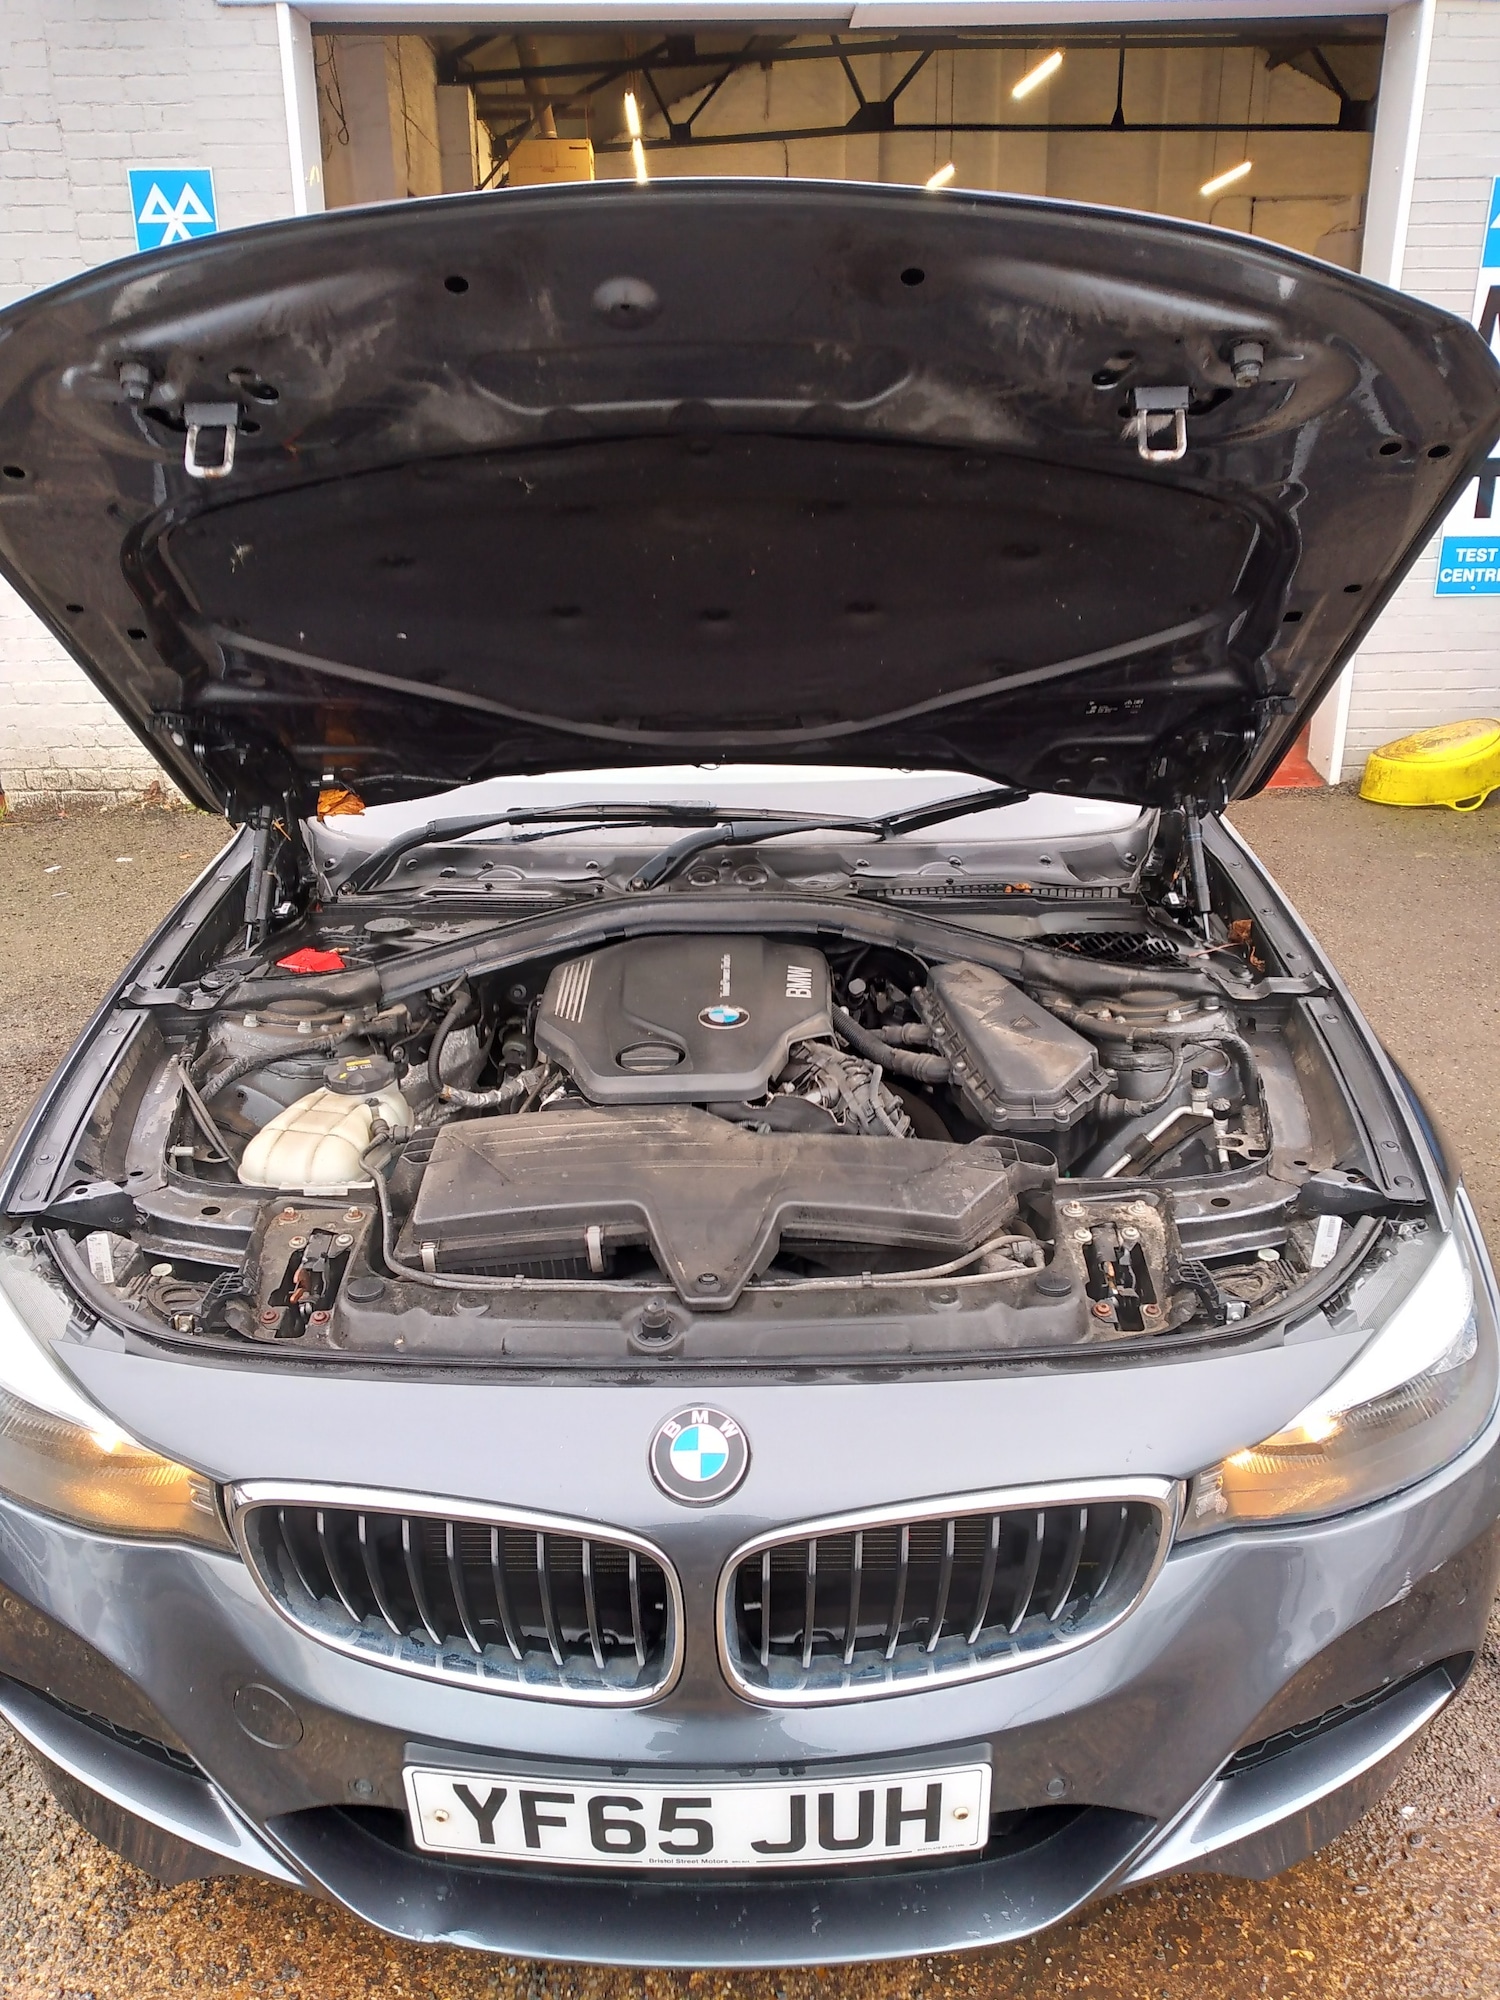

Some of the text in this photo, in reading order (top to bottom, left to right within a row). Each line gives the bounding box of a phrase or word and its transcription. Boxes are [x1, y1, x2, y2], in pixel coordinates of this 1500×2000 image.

[1456, 547, 1499, 563] TEST
[785, 965, 812, 998] BMW
[662, 1410, 739, 1439] BMW
[452, 1783, 943, 1855] YF65 JUH
